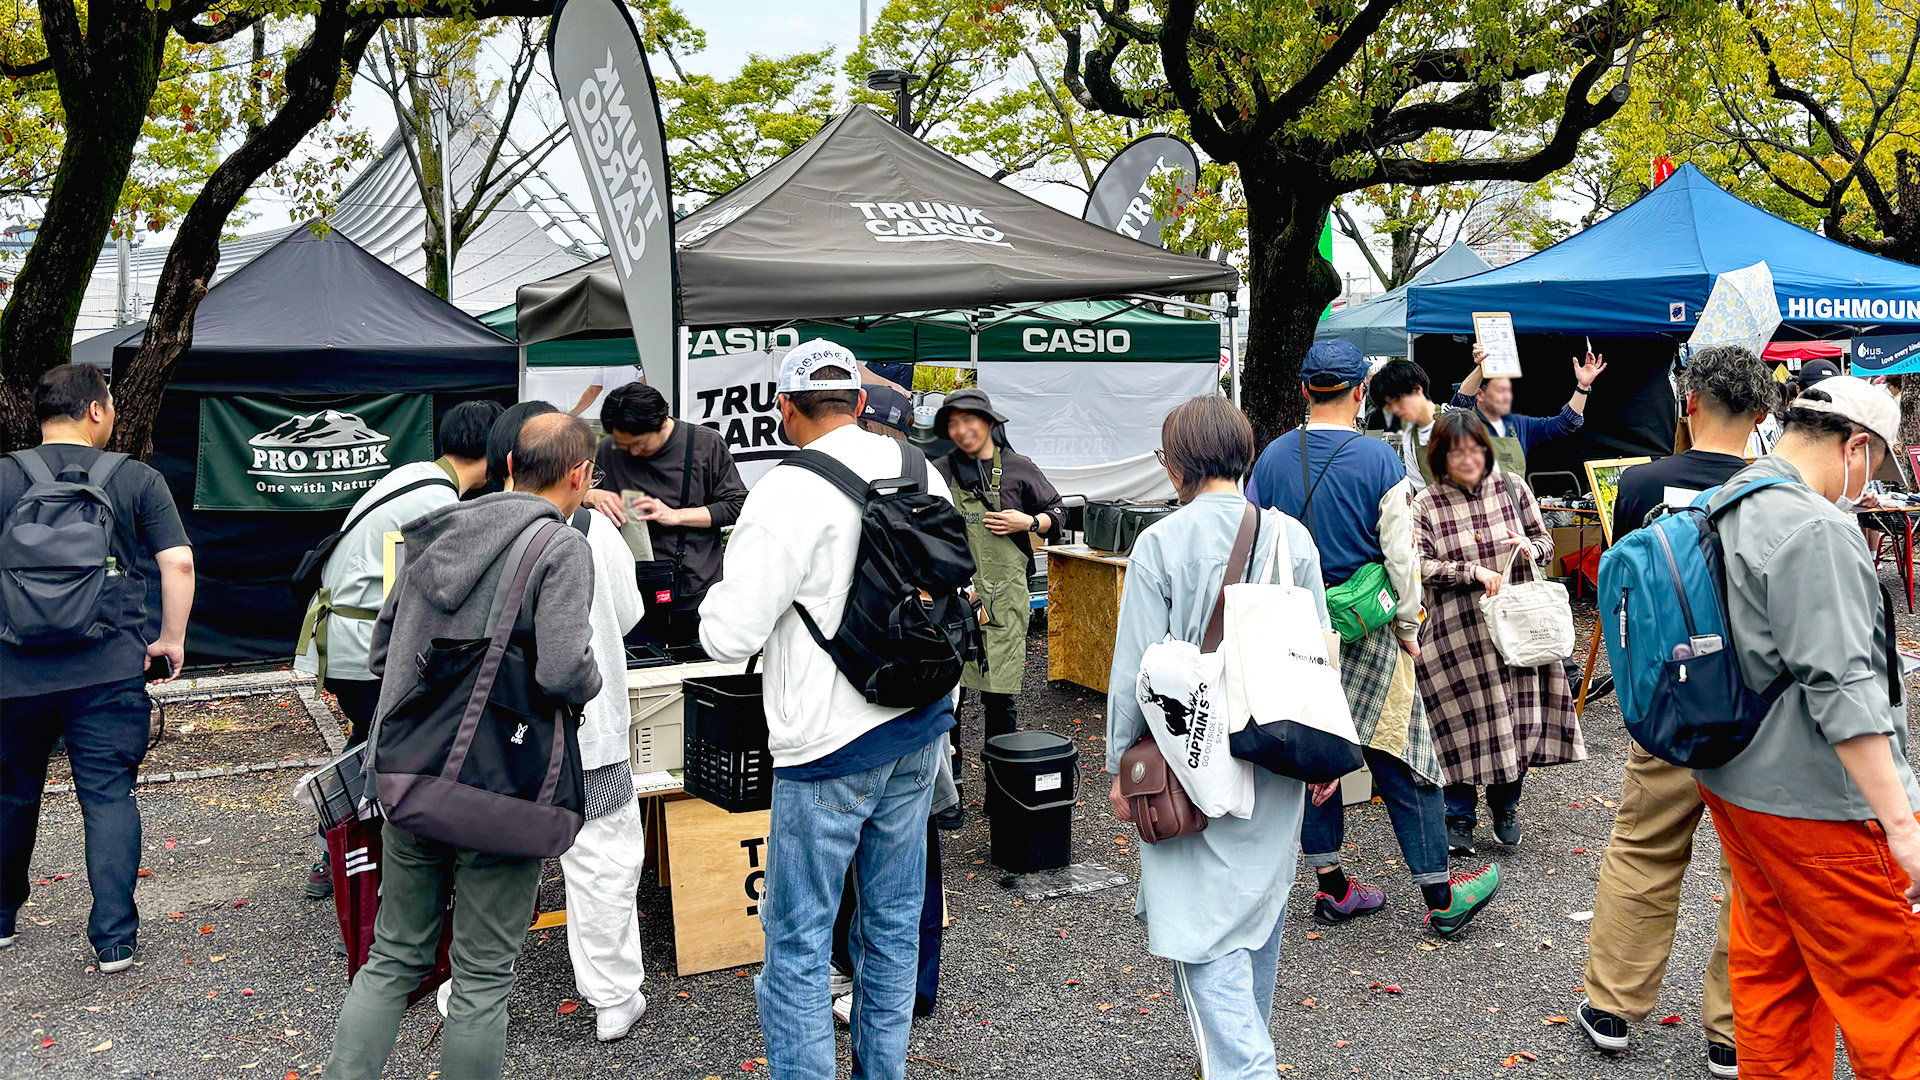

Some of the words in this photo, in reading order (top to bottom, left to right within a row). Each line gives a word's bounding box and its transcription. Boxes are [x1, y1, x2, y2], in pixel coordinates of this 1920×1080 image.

[850, 201, 994, 225] TRUNK
[865, 218, 1005, 242] CARGO
[1788, 297, 1920, 320] HIGHMOUN
[1022, 327, 1131, 353] CASIO
[795, 350, 857, 376] DODGER
[697, 382, 779, 419] TRU
[252, 448, 309, 471] PRO
[313, 444, 388, 470] TREK
[256, 481, 285, 494] One
[290, 481, 326, 494] with
[1187, 711, 1209, 769] CAPTAIN
[1204, 721, 1217, 754] OUTSIDE
